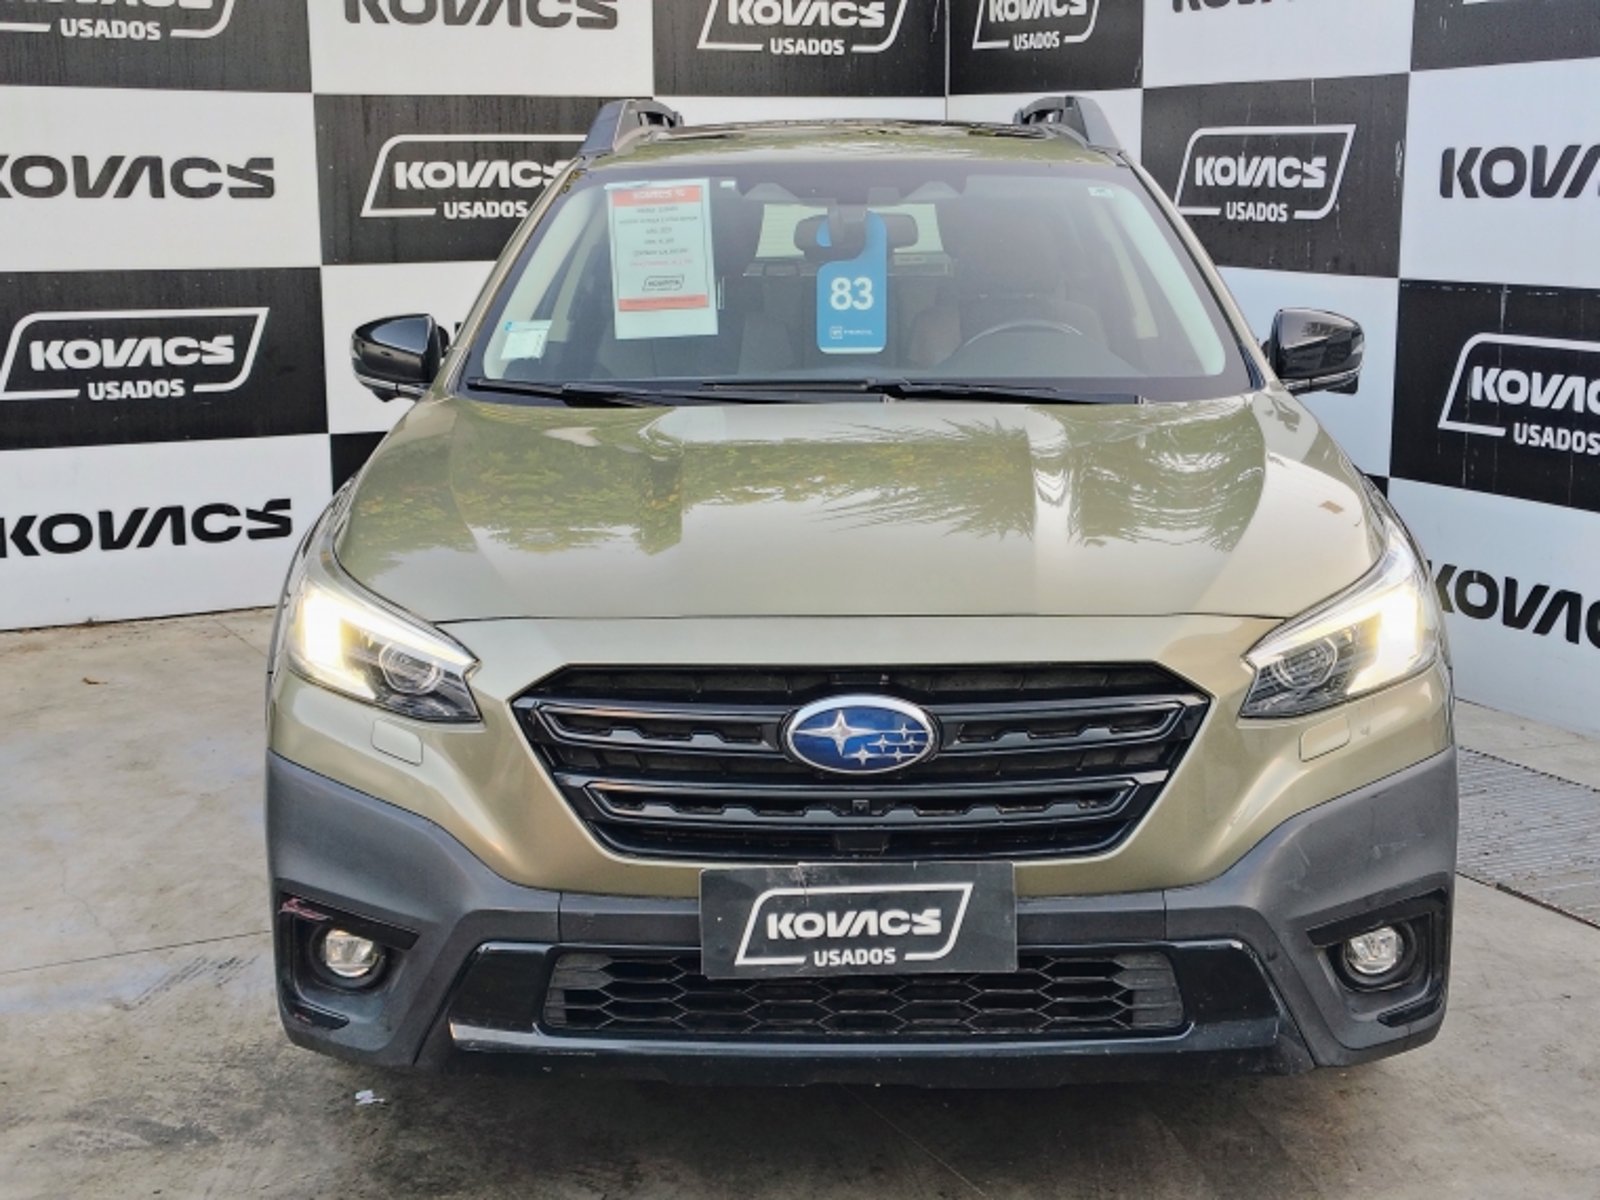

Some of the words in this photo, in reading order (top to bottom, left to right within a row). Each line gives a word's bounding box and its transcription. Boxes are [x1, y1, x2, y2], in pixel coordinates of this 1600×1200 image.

[727, 0, 886, 28] KOVACS
[988, 0, 1088, 23] KOVACS
[59, 18, 162, 41] USADOS
[1013, 31, 1060, 51] USADOS
[770, 37, 846, 56] USADOS
[0, 154, 275, 199] OVACS
[1195, 156, 1328, 189] KOVACS
[443, 200, 530, 220] USADOS
[1225, 201, 1289, 223] USADOS
[830, 276, 875, 311] 83
[29, 335, 235, 371] KOVACS
[87, 378, 185, 400] USADOS
[1512, 422, 1600, 456] USADOS
[0, 498, 293, 559] KOVACS
[766, 908, 942, 940] KOVACS
[813, 947, 897, 967] USADOS
